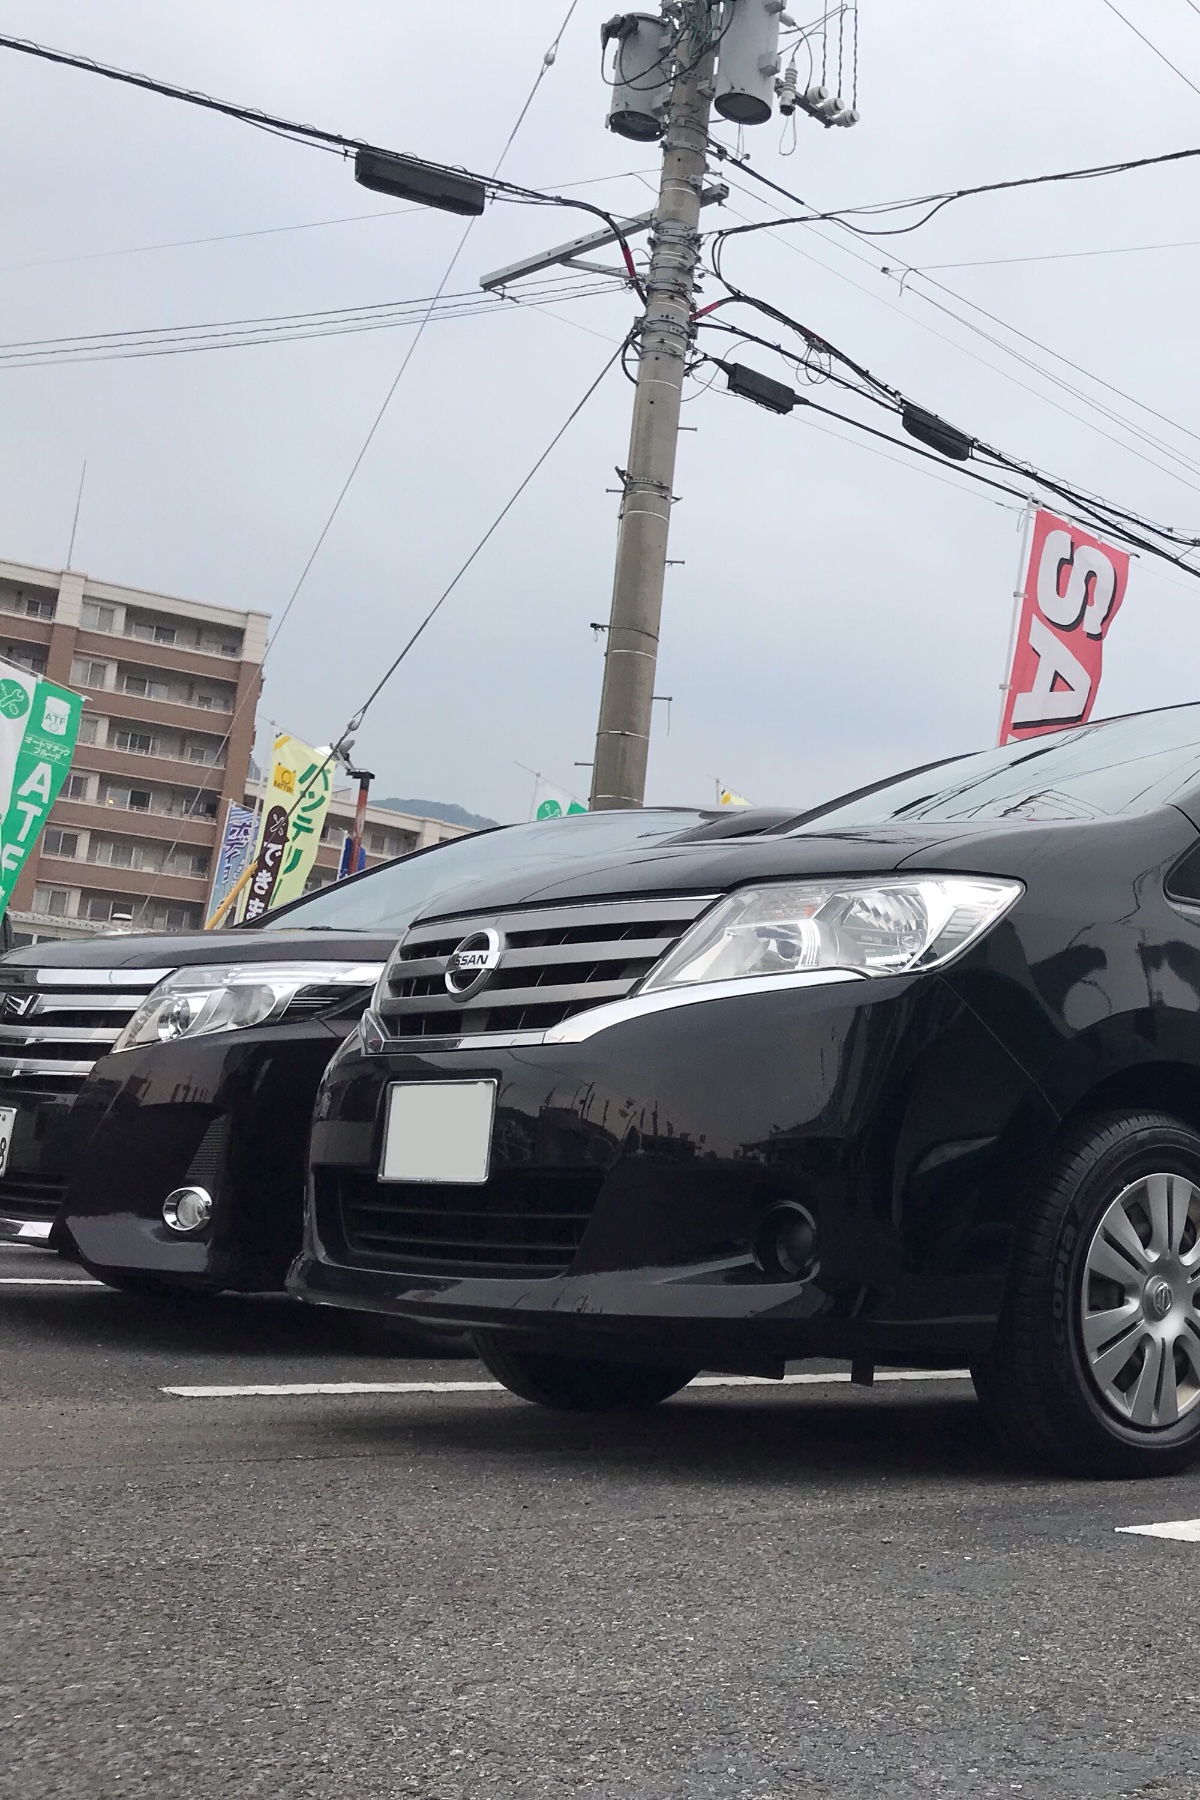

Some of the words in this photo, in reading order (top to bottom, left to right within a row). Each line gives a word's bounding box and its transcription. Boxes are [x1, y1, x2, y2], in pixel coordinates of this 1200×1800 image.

[1009, 529, 1117, 732] SA
[44, 712, 67, 726] ATF
[246, 841, 283, 921] できま
[269, 763, 331, 907] バッテリー
